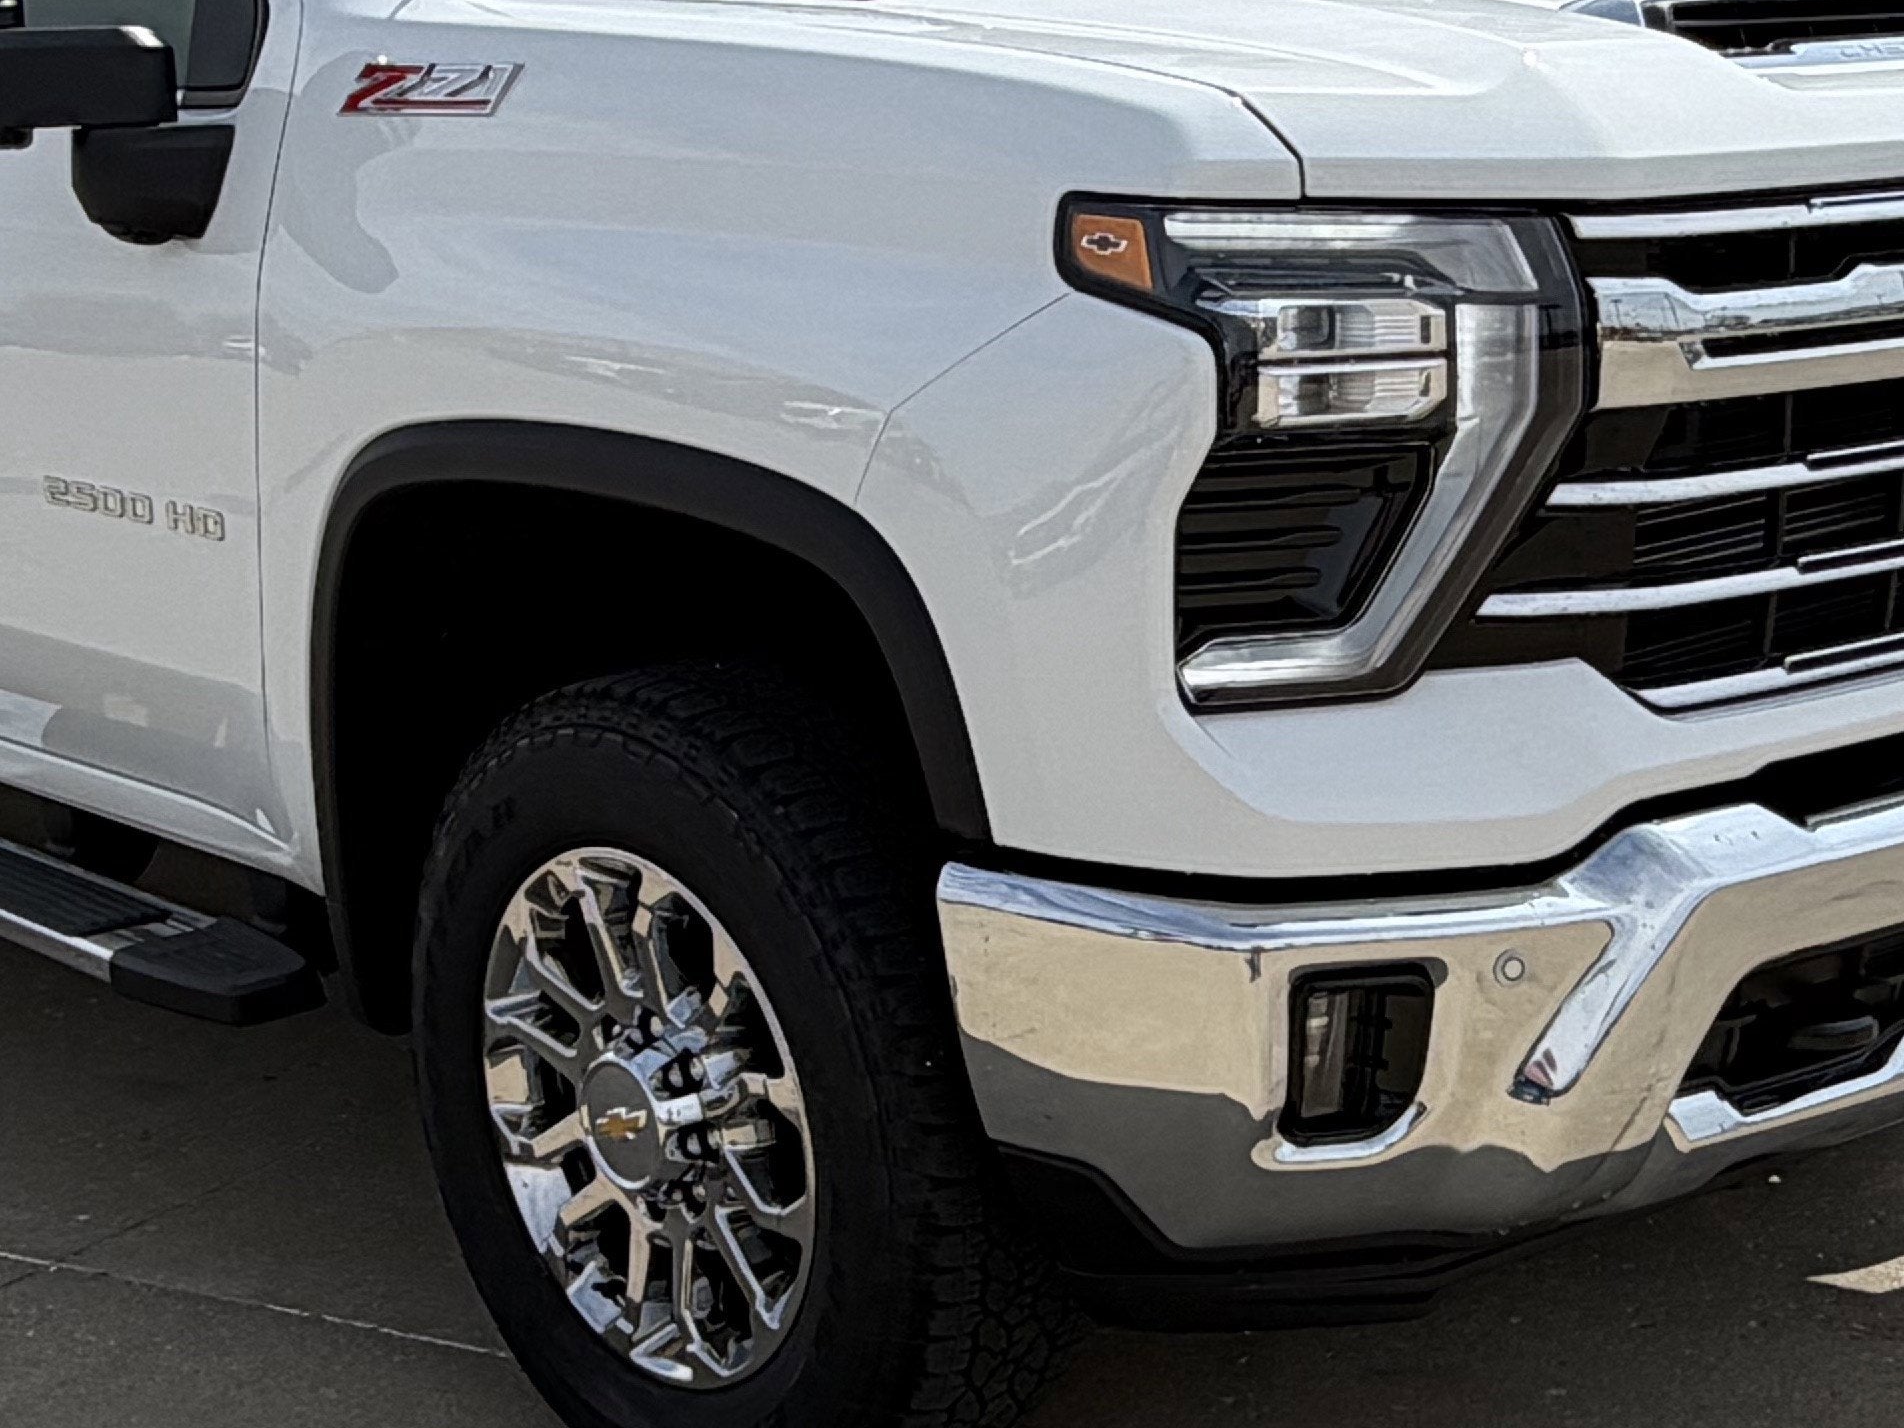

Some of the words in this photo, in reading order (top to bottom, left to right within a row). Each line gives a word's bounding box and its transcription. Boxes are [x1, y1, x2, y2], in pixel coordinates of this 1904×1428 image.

[337, 62, 525, 117] Z71
[42, 474, 155, 526] 2500
[165, 499, 227, 542] HD
